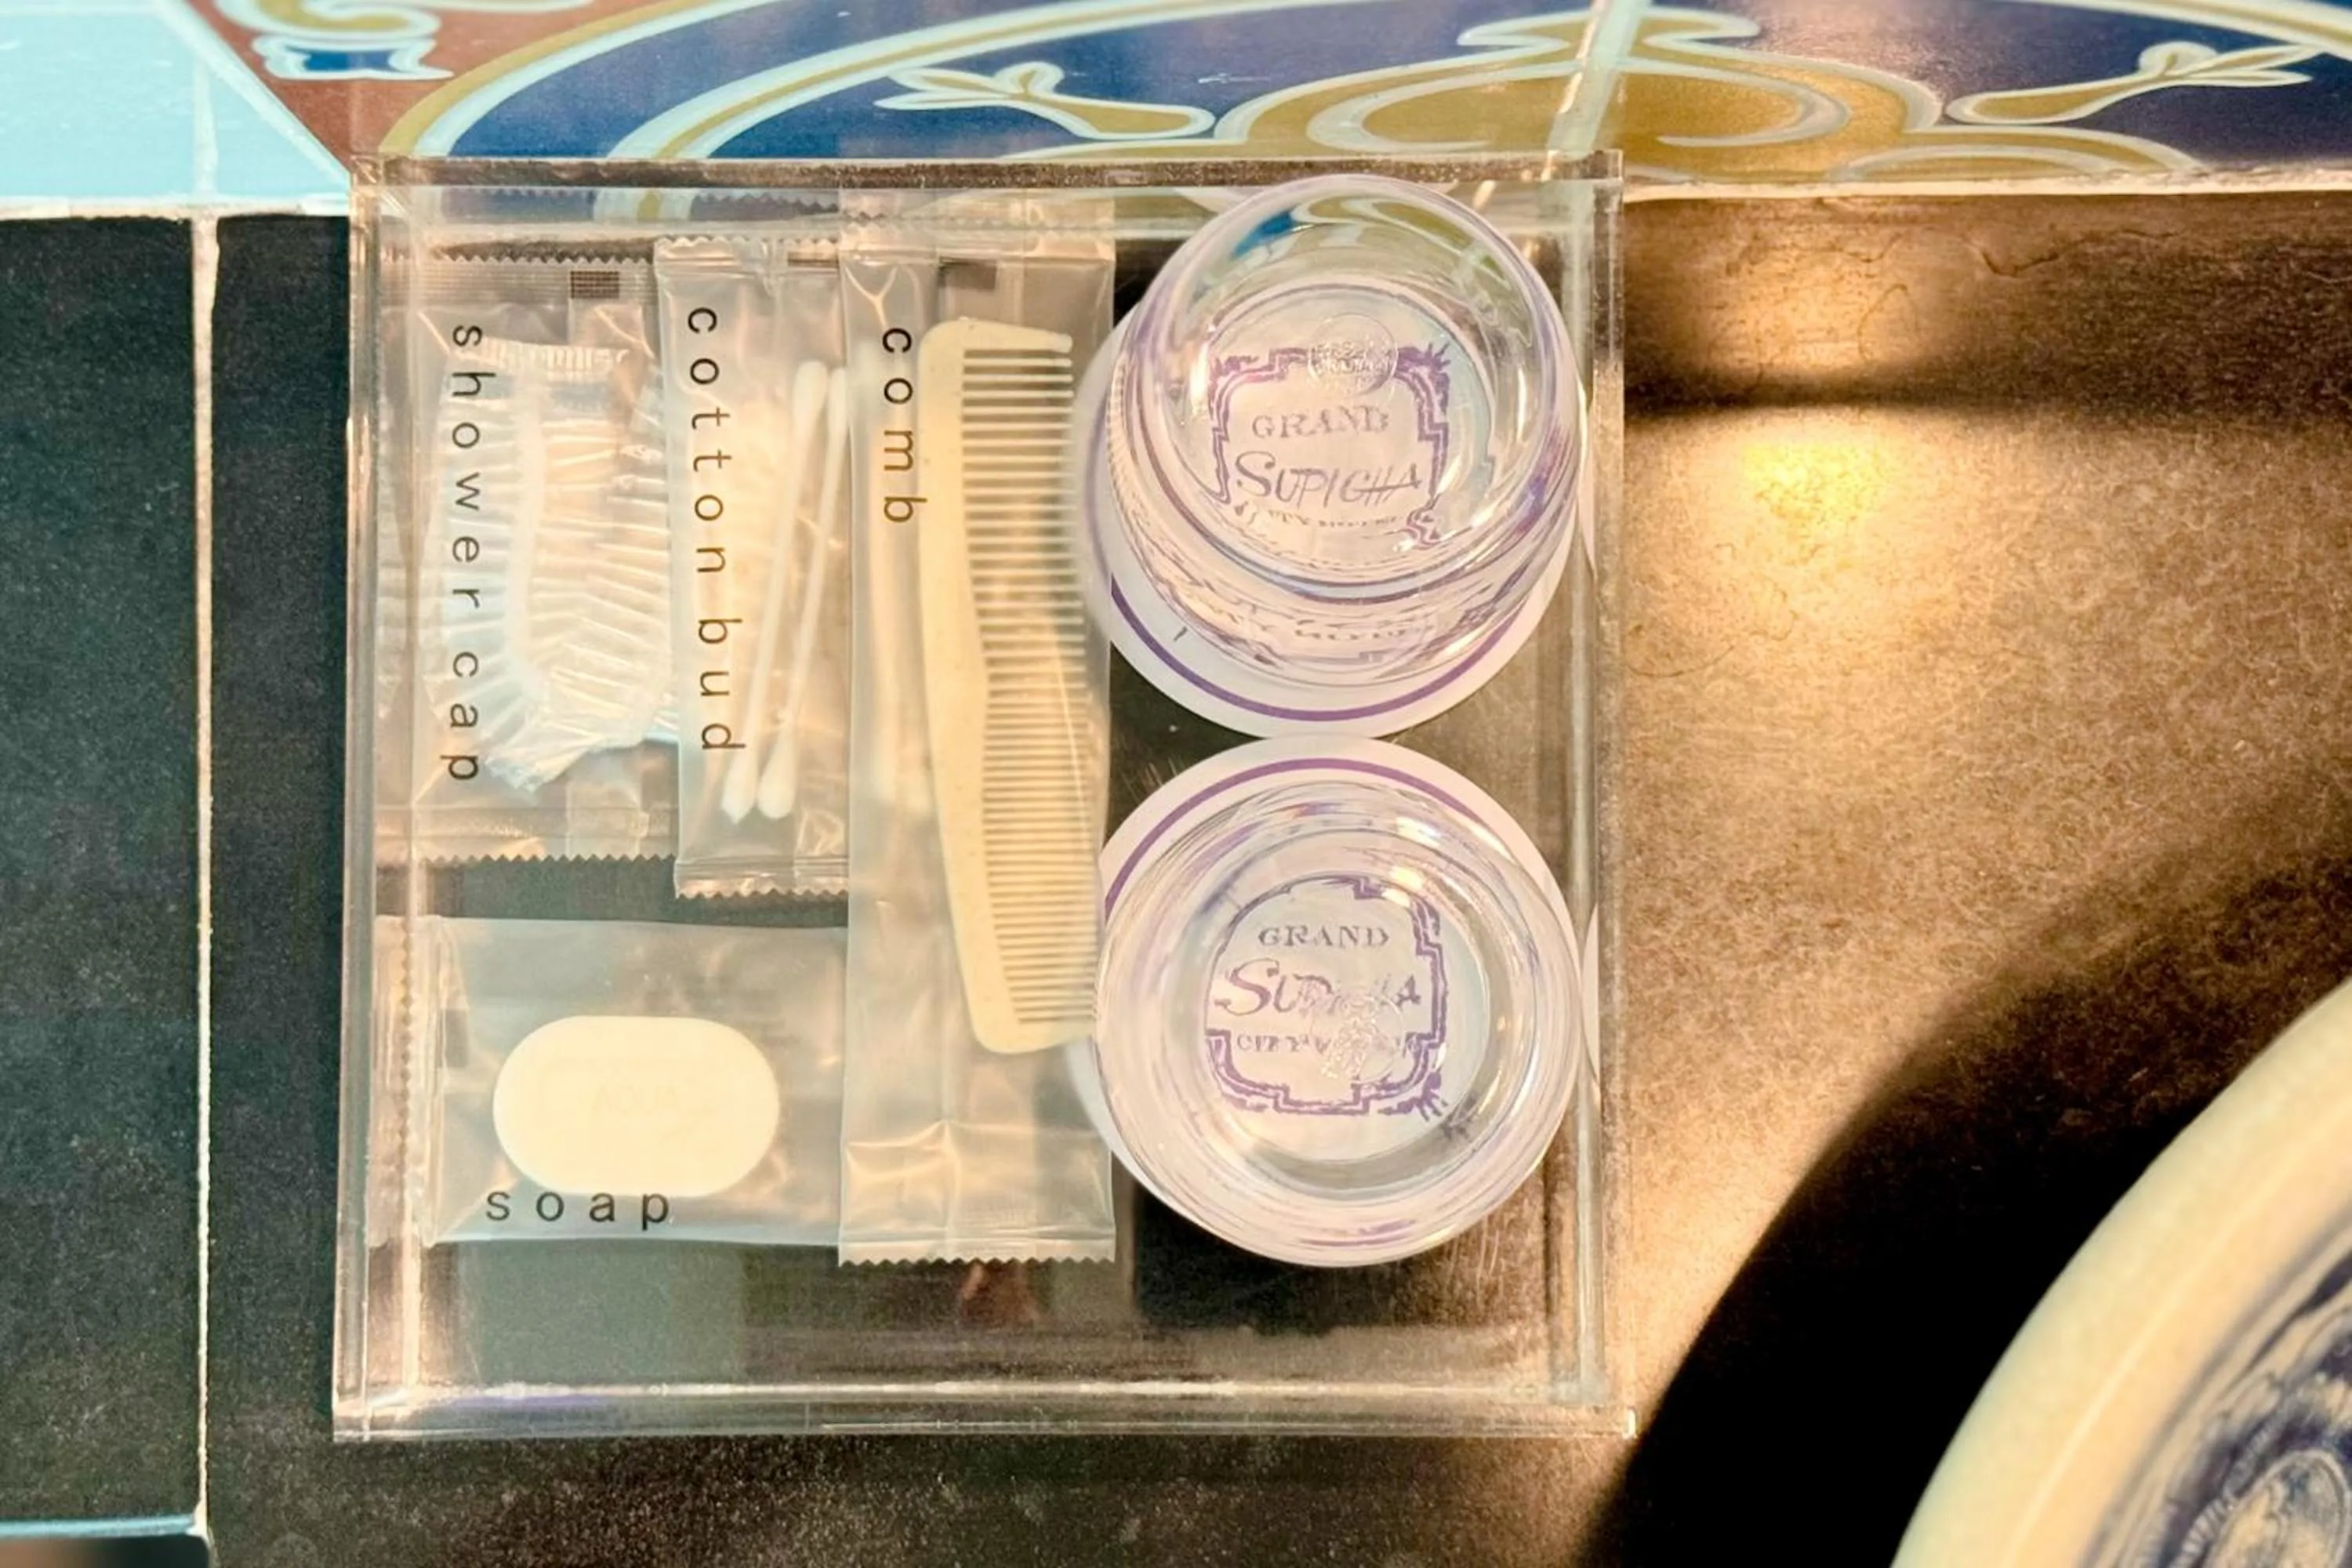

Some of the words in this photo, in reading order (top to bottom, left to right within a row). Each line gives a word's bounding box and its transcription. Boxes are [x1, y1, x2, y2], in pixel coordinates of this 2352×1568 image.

[450, 324, 496, 608] shower
[686, 307, 733, 574] cotton
[882, 328, 927, 522] comb
[1251, 405, 1390, 440] GRAND
[440, 652, 481, 782] cap
[697, 619, 746, 750] bud
[1257, 924, 1391, 949] GRAND
[485, 1191, 670, 1231] soap
